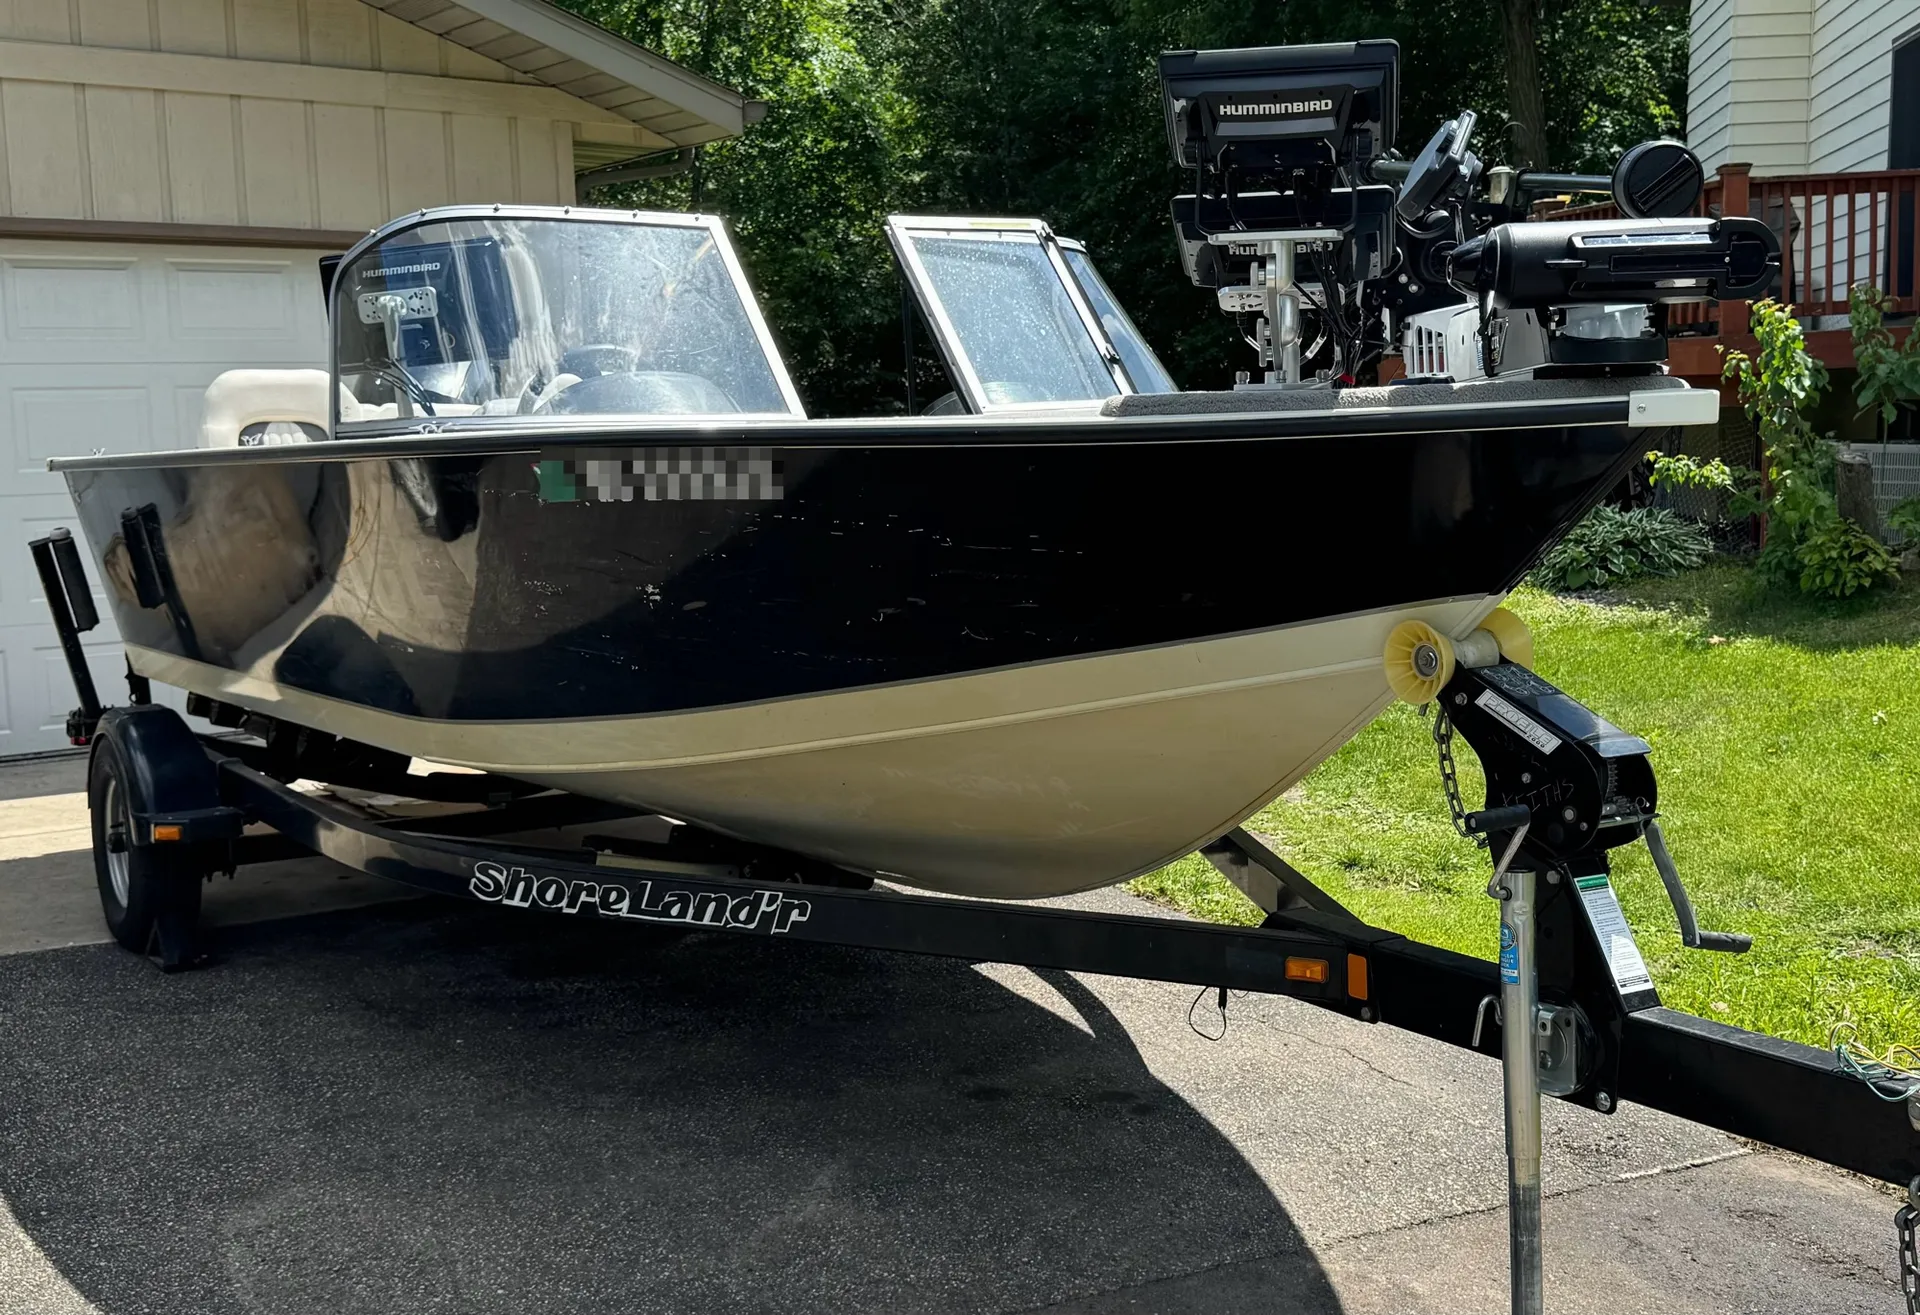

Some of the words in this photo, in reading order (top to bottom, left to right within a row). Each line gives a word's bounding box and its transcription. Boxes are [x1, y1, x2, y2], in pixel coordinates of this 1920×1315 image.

[1219, 99, 1333, 116] HUMMINBIRD
[362, 262, 441, 278] HUMMINBIRD
[1484, 695, 1553, 745] PROFILE
[1526, 733, 1546, 749] 2000
